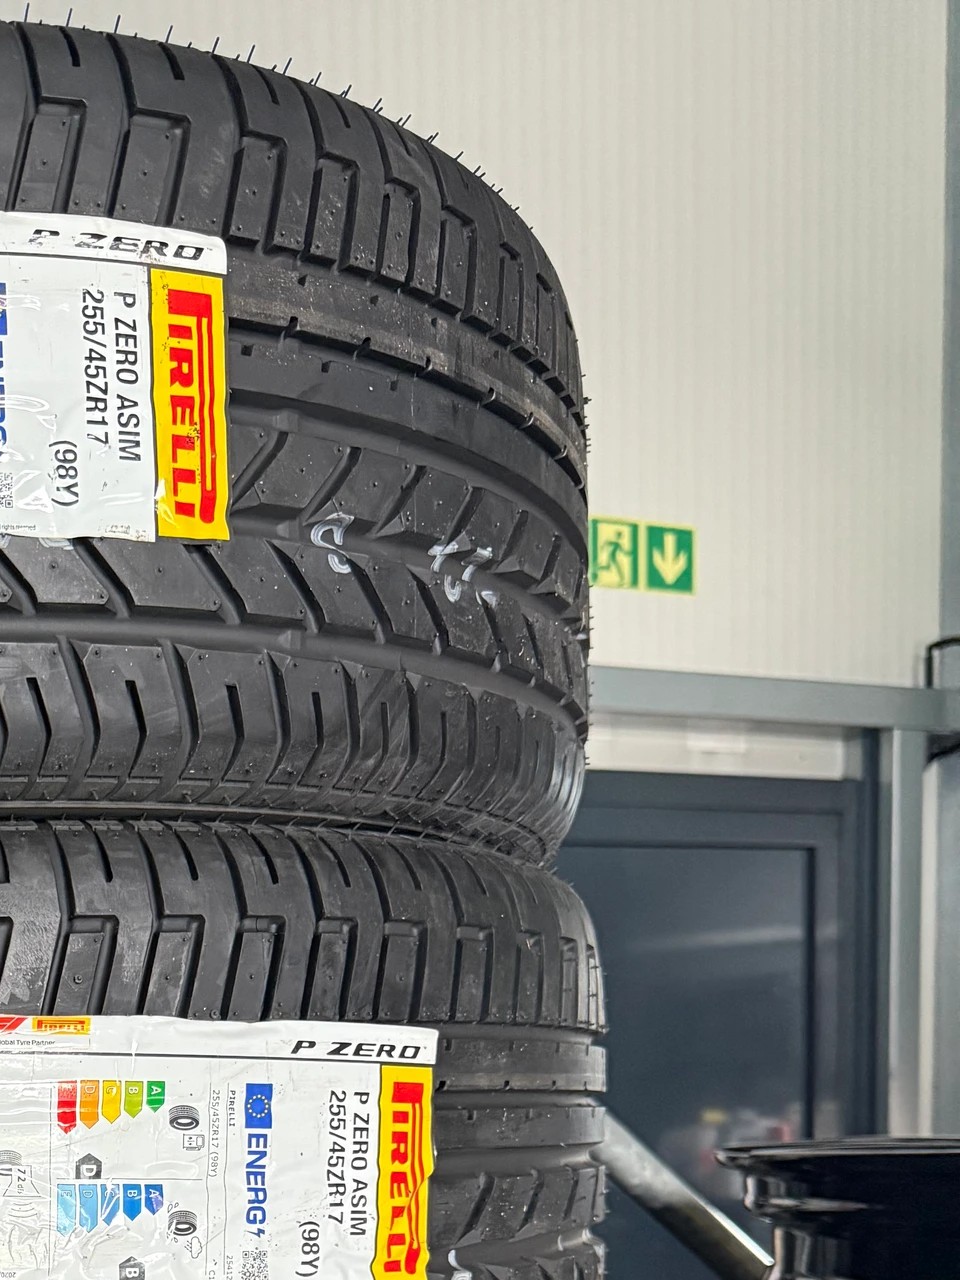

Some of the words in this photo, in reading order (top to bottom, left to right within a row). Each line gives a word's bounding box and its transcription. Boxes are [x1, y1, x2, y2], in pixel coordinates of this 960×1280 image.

[28, 229, 60, 246] P
[74, 231, 206, 261] ZERO
[113, 291, 136, 309] P
[113, 317, 140, 385] ZERO
[81, 287, 110, 447] 255/45ZR17
[168, 289, 217, 524] PIRELLI
[115, 393, 142, 462] ASIM
[48, 440, 79, 507] (98Y)
[16, 1038, 31, 1047] Tyre
[31, 1038, 55, 1046] Partner
[290, 1040, 317, 1055] P
[326, 1041, 421, 1059] ZERO
[84, 1085, 96, 1094] D
[128, 1086, 139, 1095] B
[150, 1085, 161, 1095] A
[353, 1091, 370, 1105] P
[210, 1089, 221, 1149] 255/45ZR17
[228, 1089, 237, 1127] PIRELLI
[350, 1112, 370, 1171] ZERO
[82, 1164, 97, 1177] D
[208, 1151, 219, 1178] (98Y)
[327, 1089, 347, 1226] 255/45ZR17
[17, 1168, 27, 1183] 72
[245, 1133, 268, 1225] ENERG
[383, 1081, 425, 1275] PIRELLI
[82, 1190, 93, 1198] D
[127, 1189, 138, 1197] B
[149, 1188, 159, 1198] A
[349, 1178, 368, 1236] ASIM
[295, 1220, 320, 1278] (98Y)
[125, 1267, 139, 1278] B
